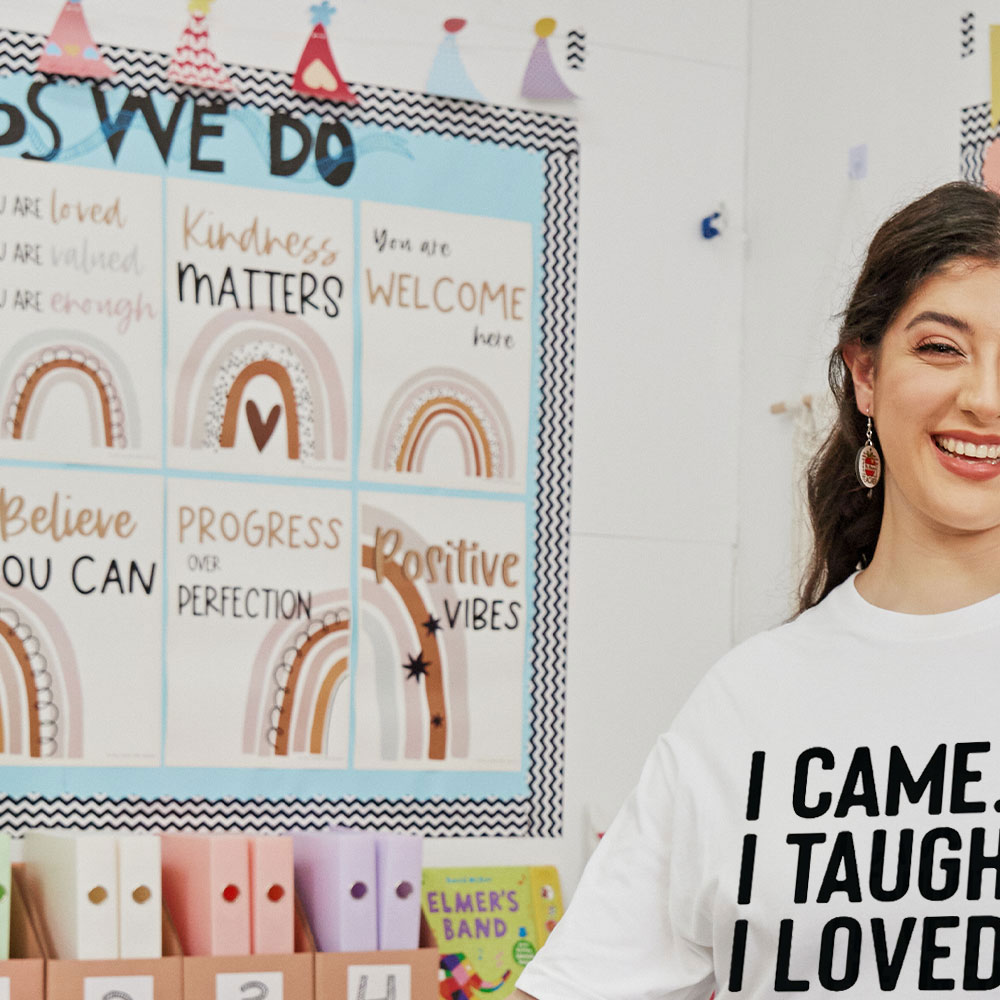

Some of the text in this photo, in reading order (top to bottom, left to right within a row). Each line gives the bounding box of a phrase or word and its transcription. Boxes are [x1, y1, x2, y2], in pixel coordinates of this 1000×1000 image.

[90, 86, 230, 173] WE
[270, 112, 356, 187] DO
[14, 198, 43, 219] ARE
[50, 187, 127, 229] loved
[182, 205, 339, 266] Kindness
[373, 227, 452, 257] You are
[13, 244, 43, 267] ARE
[50, 240, 145, 276] valued
[13, 291, 43, 313] ARE
[50, 290, 156, 334] enough
[366, 268, 526, 322] WELCOME
[472, 323, 515, 351] here
[0, 487, 137, 543] Believe
[179, 506, 344, 549] PROGRESS
[0, 555, 156, 595] OU CAN
[187, 554, 221, 574] OVER
[373, 527, 520, 588] Positive
[177, 584, 312, 620] PERFECTION
[443, 597, 522, 631] VIBES
[746, 750, 766, 821] I
[738, 833, 757, 905] I
[427, 890, 519, 913] ELMER'S
[443, 918, 507, 940] BAND
[728, 919, 748, 993] I
